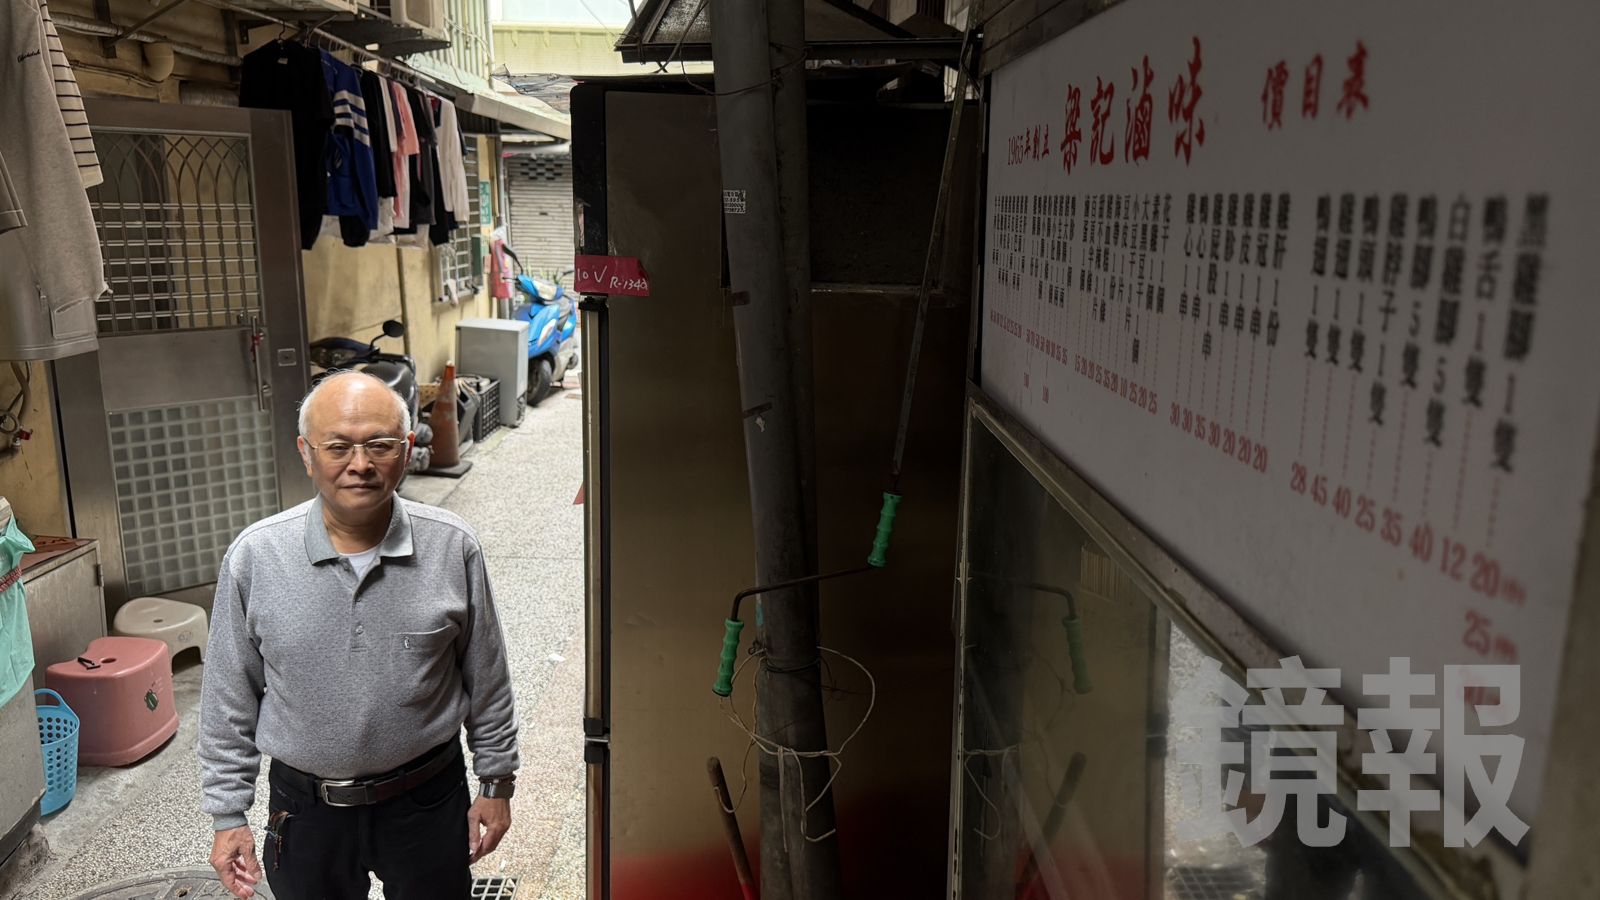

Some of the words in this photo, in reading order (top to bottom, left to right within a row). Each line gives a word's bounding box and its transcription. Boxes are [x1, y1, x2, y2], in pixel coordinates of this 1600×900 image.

[1061, 36, 1205, 176] 梁記滷味
[1169, 402, 1180, 426] 30
[1181, 407, 1192, 433] 30
[1193, 413, 1205, 440] 35
[1207, 421, 1220, 448] 30
[1222, 427, 1235, 456] 20
[1237, 435, 1251, 464] 20
[1252, 442, 1268, 473] 20
[1289, 461, 1307, 495] 28
[1310, 473, 1327, 507] 45
[1332, 484, 1351, 519] 40
[1354, 493, 1376, 532] 25
[1379, 505, 1402, 546] 35
[1409, 520, 1432, 562] 40
[1440, 535, 1467, 581] 12
[1468, 550, 1501, 599] 20
[1462, 608, 1491, 656] 25
